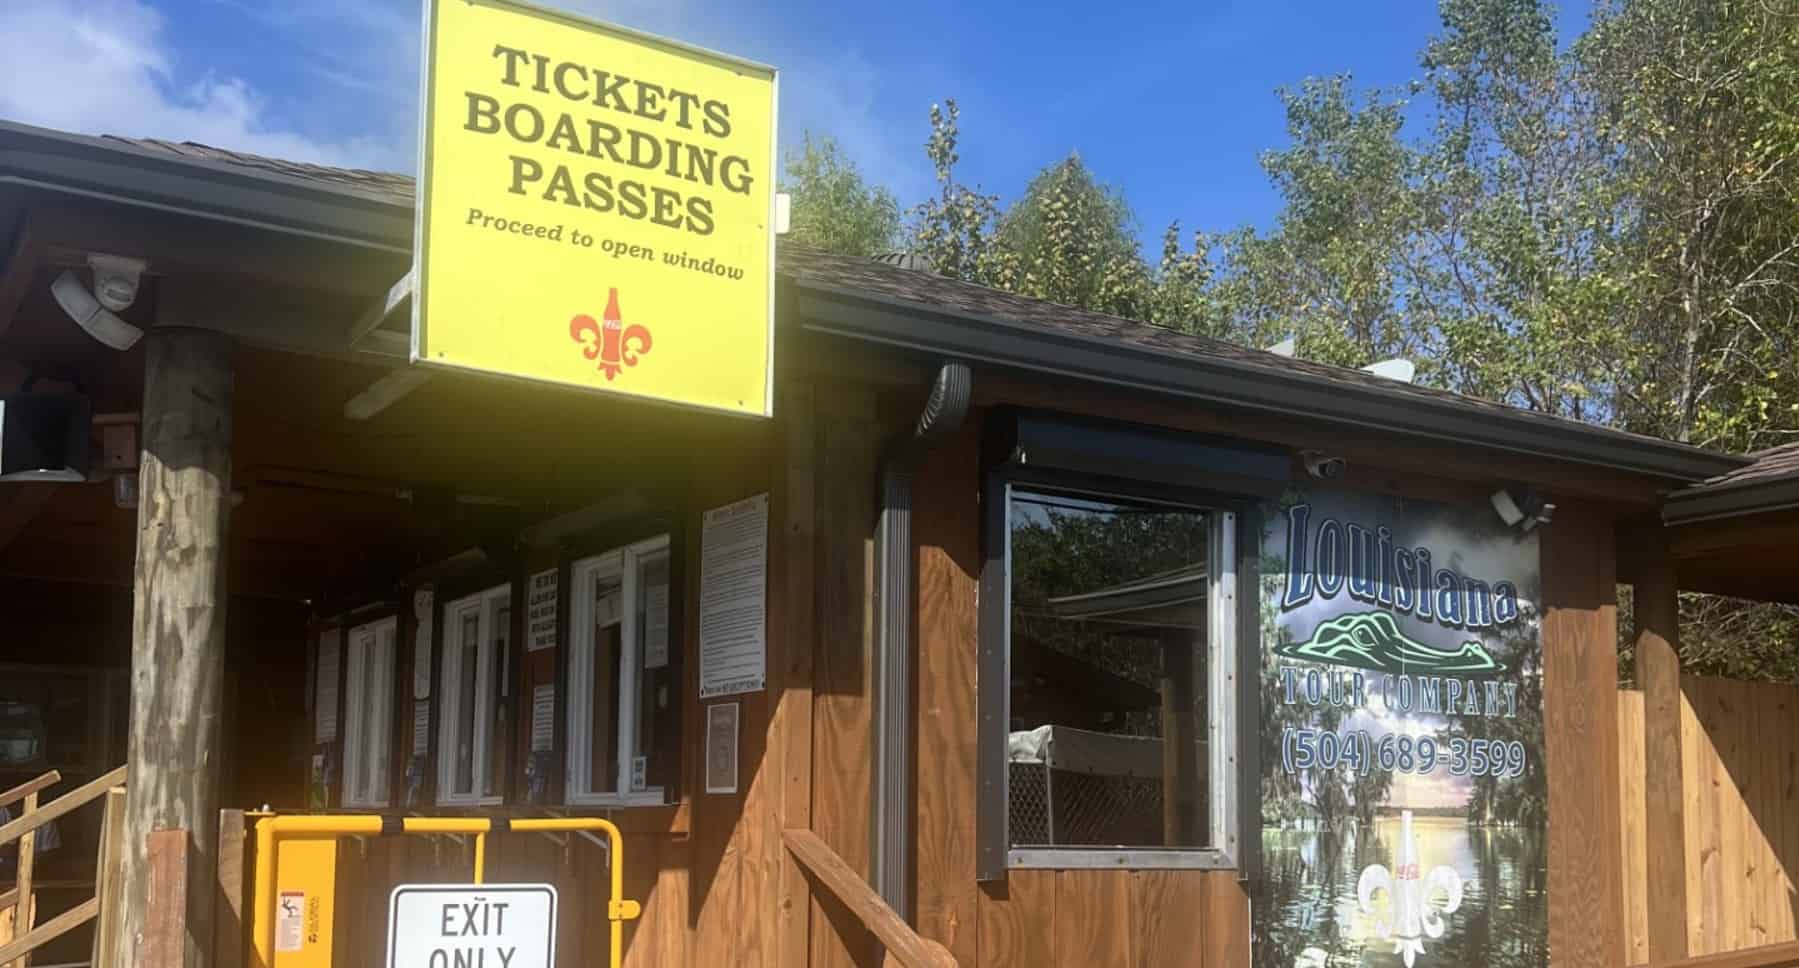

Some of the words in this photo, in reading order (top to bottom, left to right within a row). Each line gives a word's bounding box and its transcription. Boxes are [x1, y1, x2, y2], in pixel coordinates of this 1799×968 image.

[492, 43, 731, 138] TICKETS
[463, 91, 754, 196] BOARDING
[507, 154, 715, 237] PASSES
[466, 208, 563, 242] Proceed
[571, 228, 593, 248] to
[601, 238, 655, 262] open
[663, 250, 744, 281] window
[1281, 503, 1519, 632] Louisiana
[1280, 666, 1367, 707] TOUR
[1383, 674, 1518, 719] COMPANY
[1282, 728, 1370, 777] (504)
[1377, 735, 1526, 778] 689-3599
[441, 903, 509, 936] EXIT
